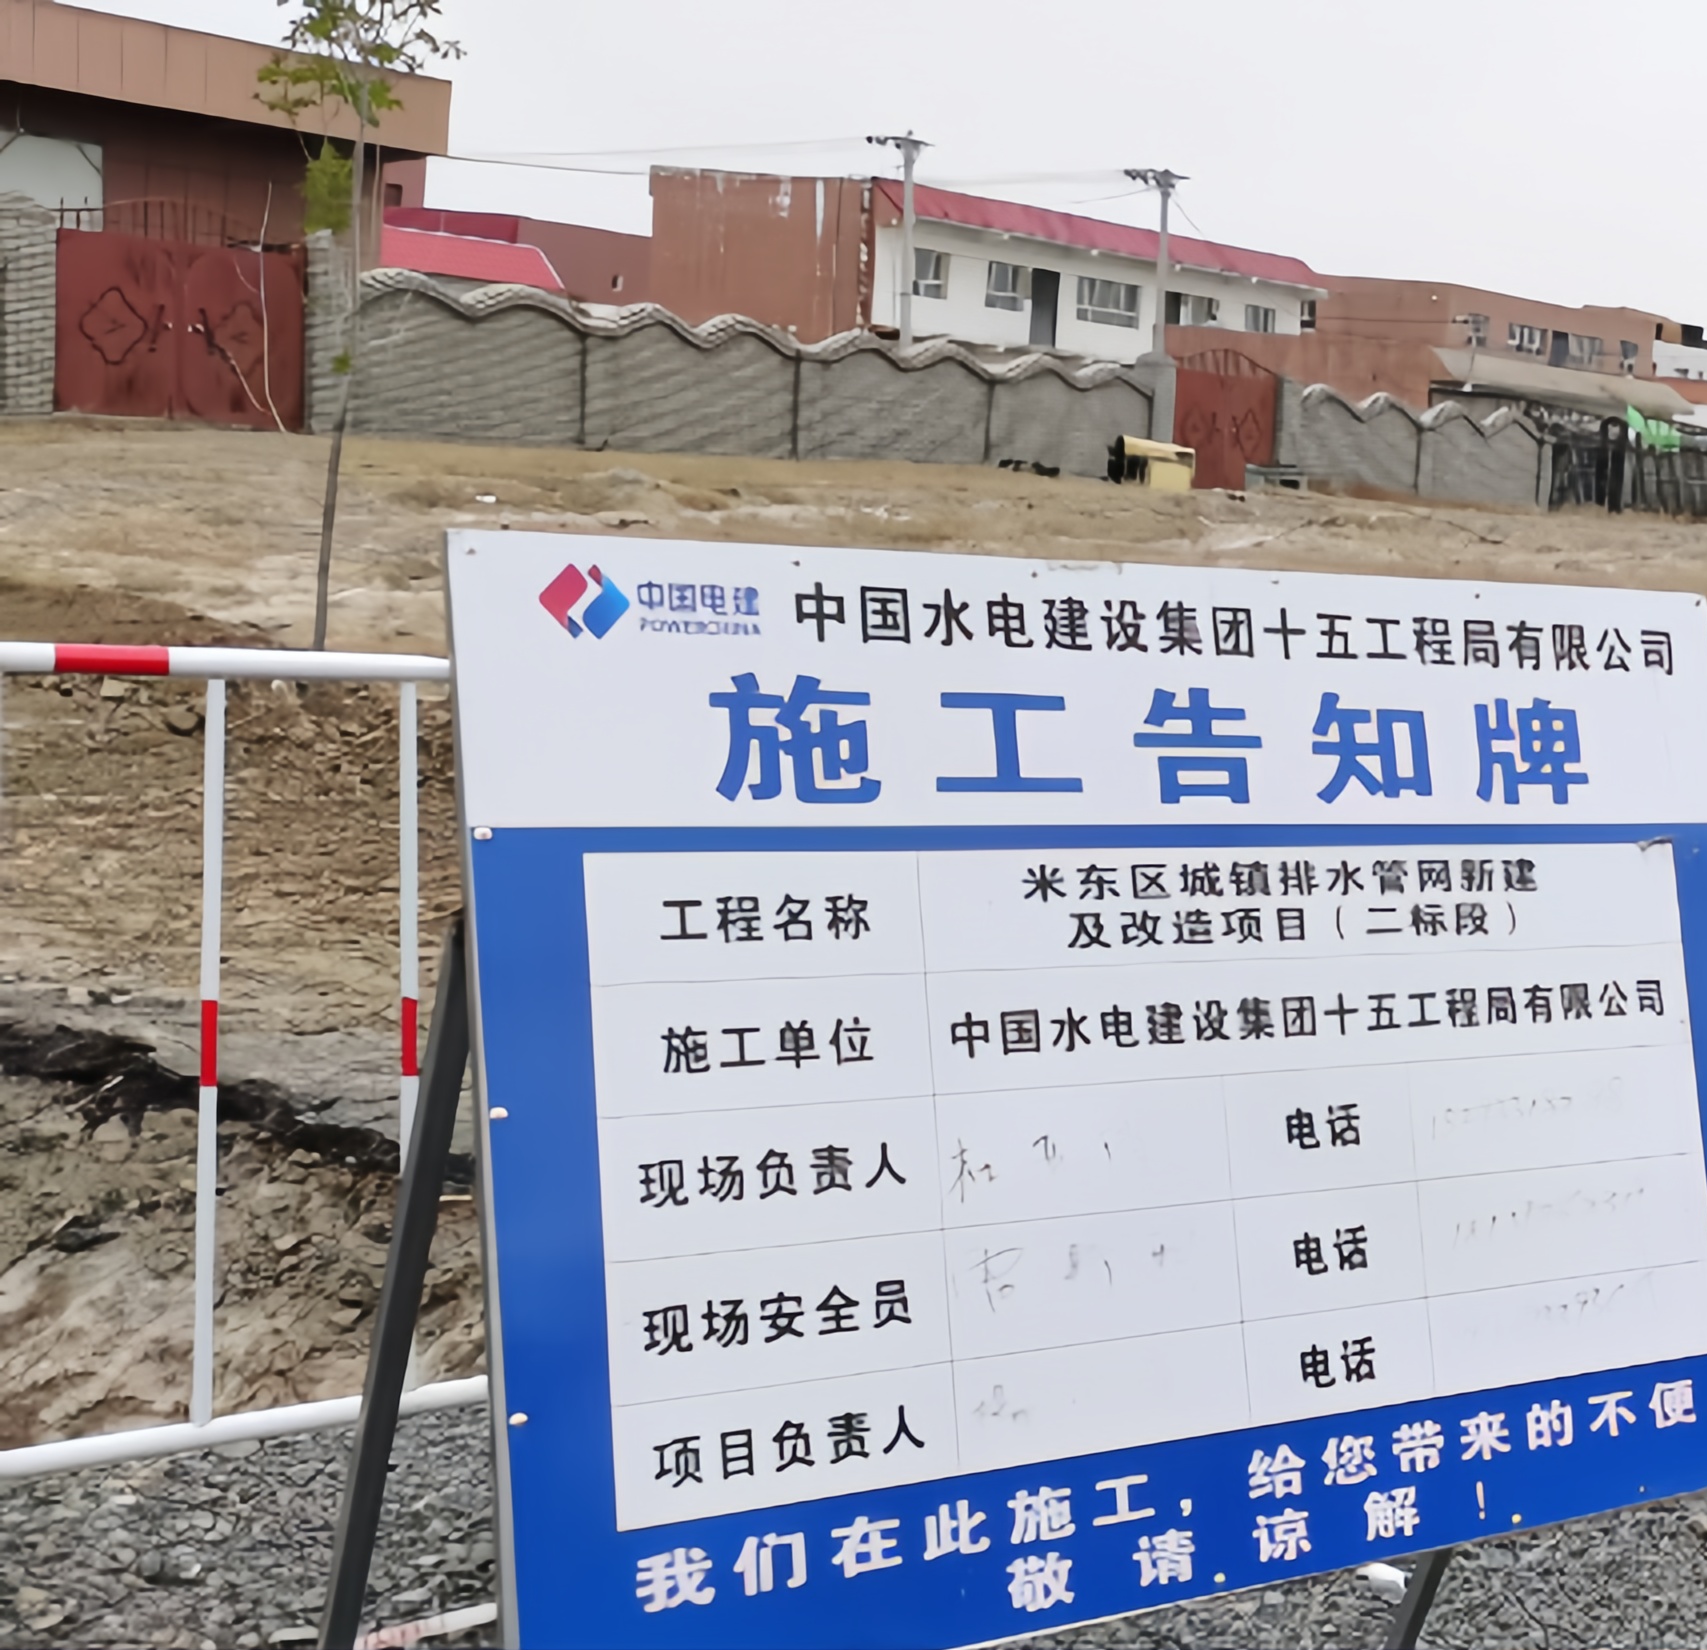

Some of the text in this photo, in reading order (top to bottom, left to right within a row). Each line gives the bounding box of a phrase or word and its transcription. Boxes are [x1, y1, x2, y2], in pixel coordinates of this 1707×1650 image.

[637, 580, 760, 617] 中国电建
[794, 581, 1674, 676] 中国水电建设集团十五工程局有限公司
[708, 671, 1590, 805] 施工告知牌
[1022, 858, 1539, 902] 米东区城镇排水管网新建
[660, 893, 871, 944] 工程名称
[660, 1016, 874, 1074] 施工单位
[950, 979, 1665, 1059] 中国水电建设集团十五工程局有限公司
[1285, 1103, 1361, 1150] 电话
[638, 1142, 907, 1208] 现场负责人
[1292, 1224, 1368, 1276] 电话
[642, 1279, 912, 1356] 现场安全员
[1300, 1335, 1376, 1389] 电话
[652, 1404, 925, 1489] 项目负责人
